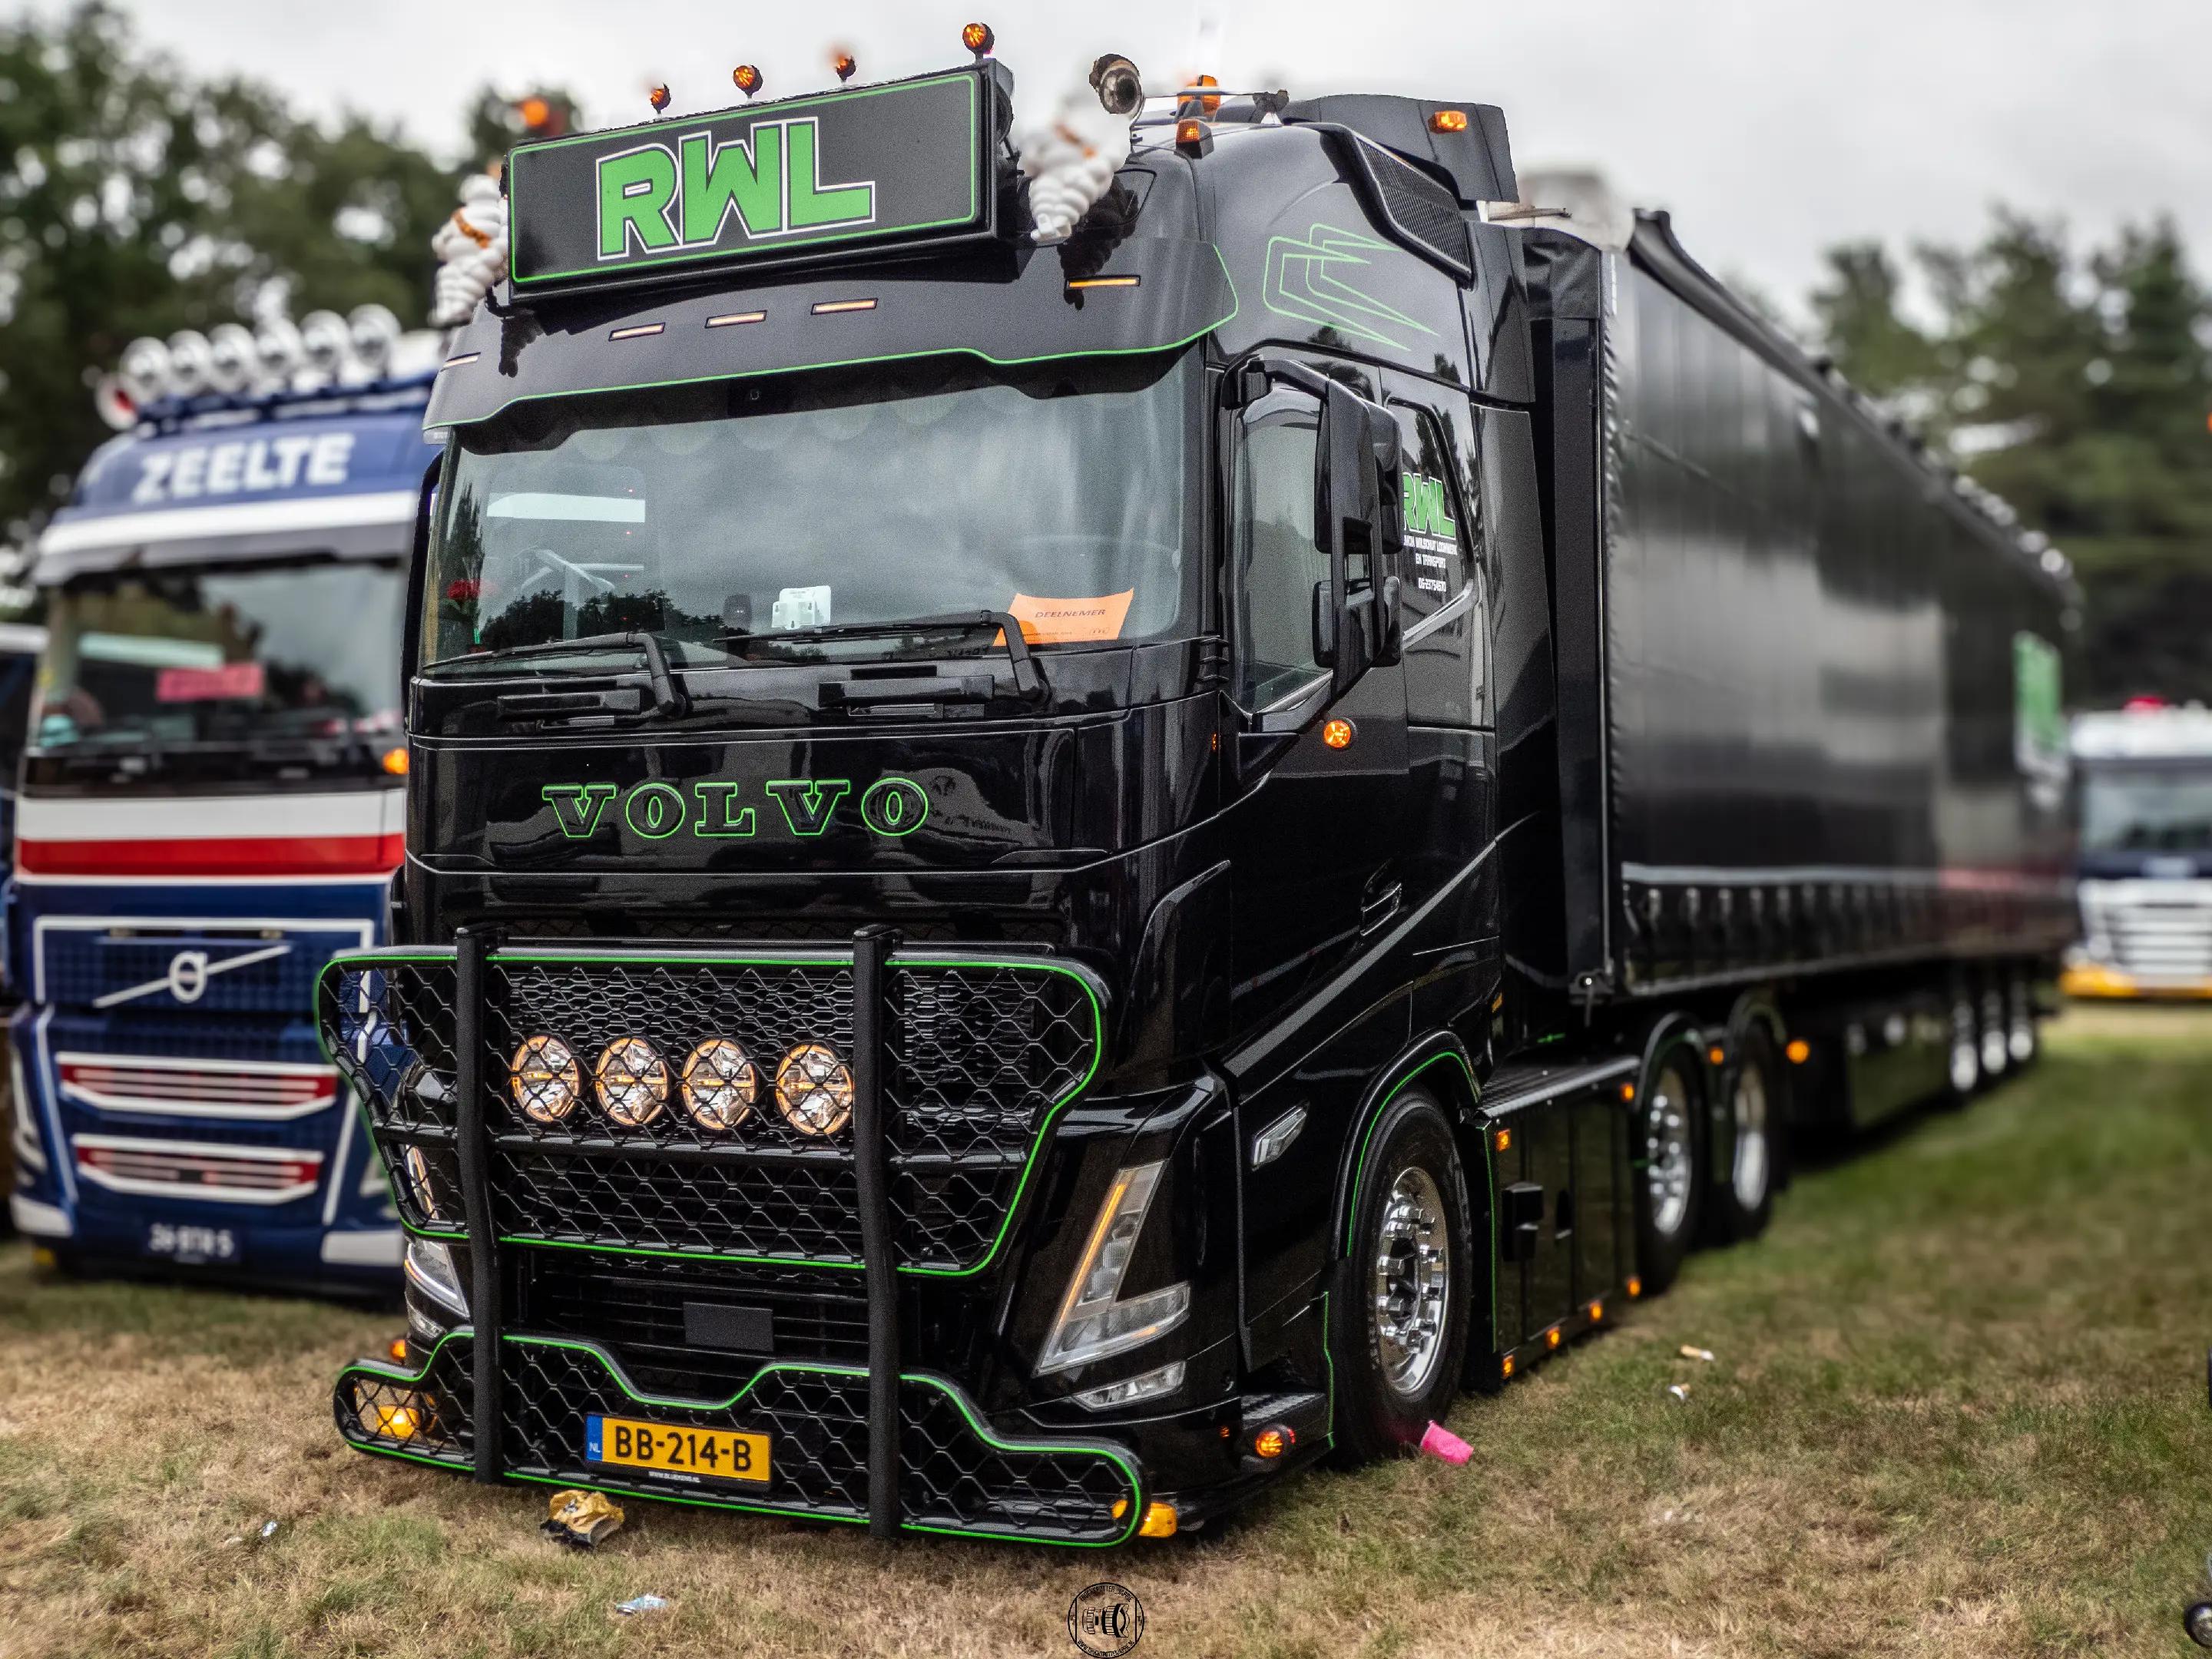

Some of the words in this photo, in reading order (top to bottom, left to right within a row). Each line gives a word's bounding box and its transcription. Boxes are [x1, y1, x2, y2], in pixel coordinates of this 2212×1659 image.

[597, 116, 876, 260] RWL
[131, 432, 356, 505] ZEELTE
[1402, 472, 1456, 541] RWL
[1422, 554, 1446, 568] TRANSPORT
[1035, 609, 1106, 618] DEELNEMER
[542, 778, 929, 839] VOLVO
[588, 1442, 601, 1454] NL
[615, 1426, 751, 1472] BB-214-B
